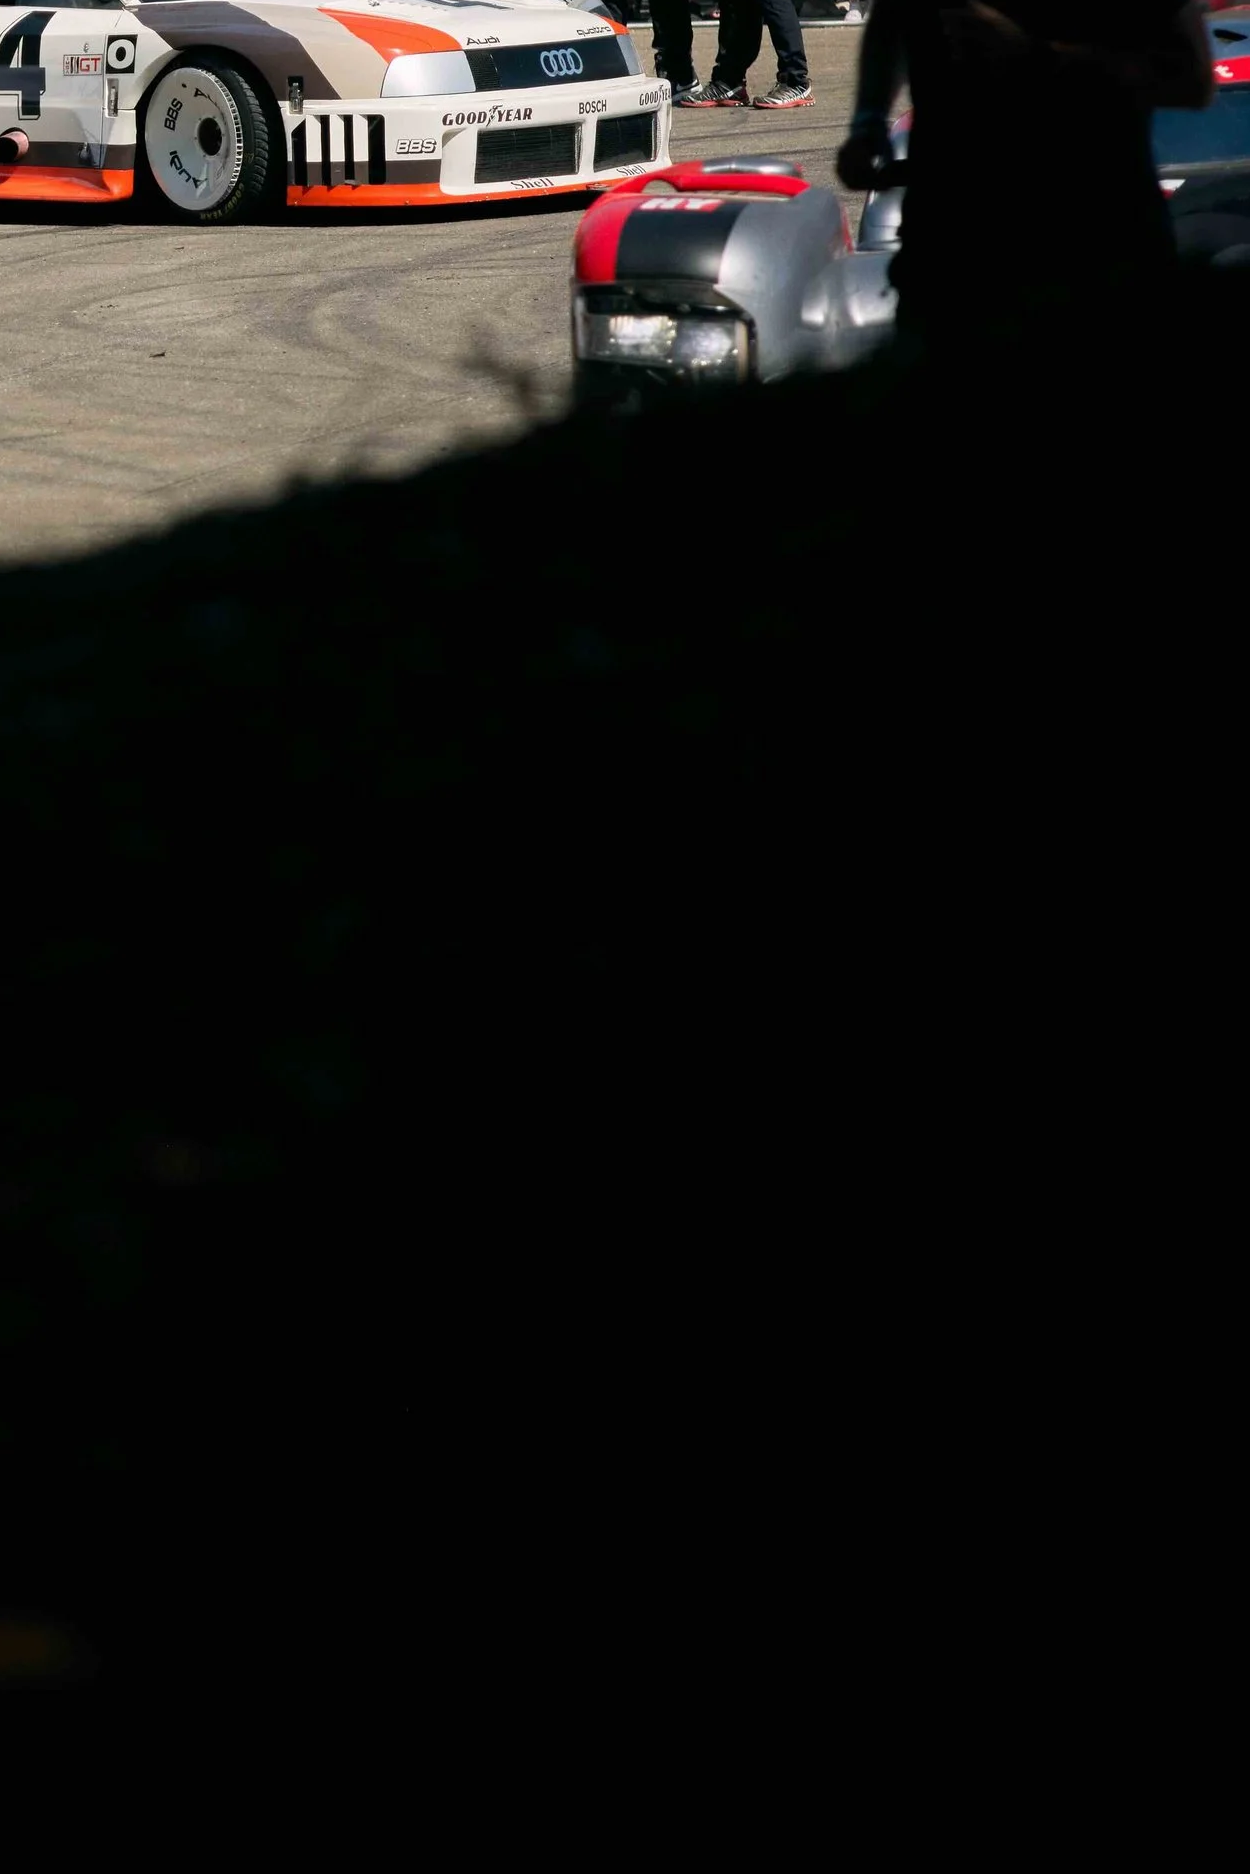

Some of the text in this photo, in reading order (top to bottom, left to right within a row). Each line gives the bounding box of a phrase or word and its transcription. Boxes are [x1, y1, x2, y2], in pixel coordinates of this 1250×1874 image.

[466, 25, 612, 46] Audi quattro
[80, 57, 101, 72] GT
[163, 97, 184, 132] BBS
[578, 99, 608, 115] BOSCH
[395, 138, 437, 155] BBS
[510, 165, 648, 191] Shell Shell
